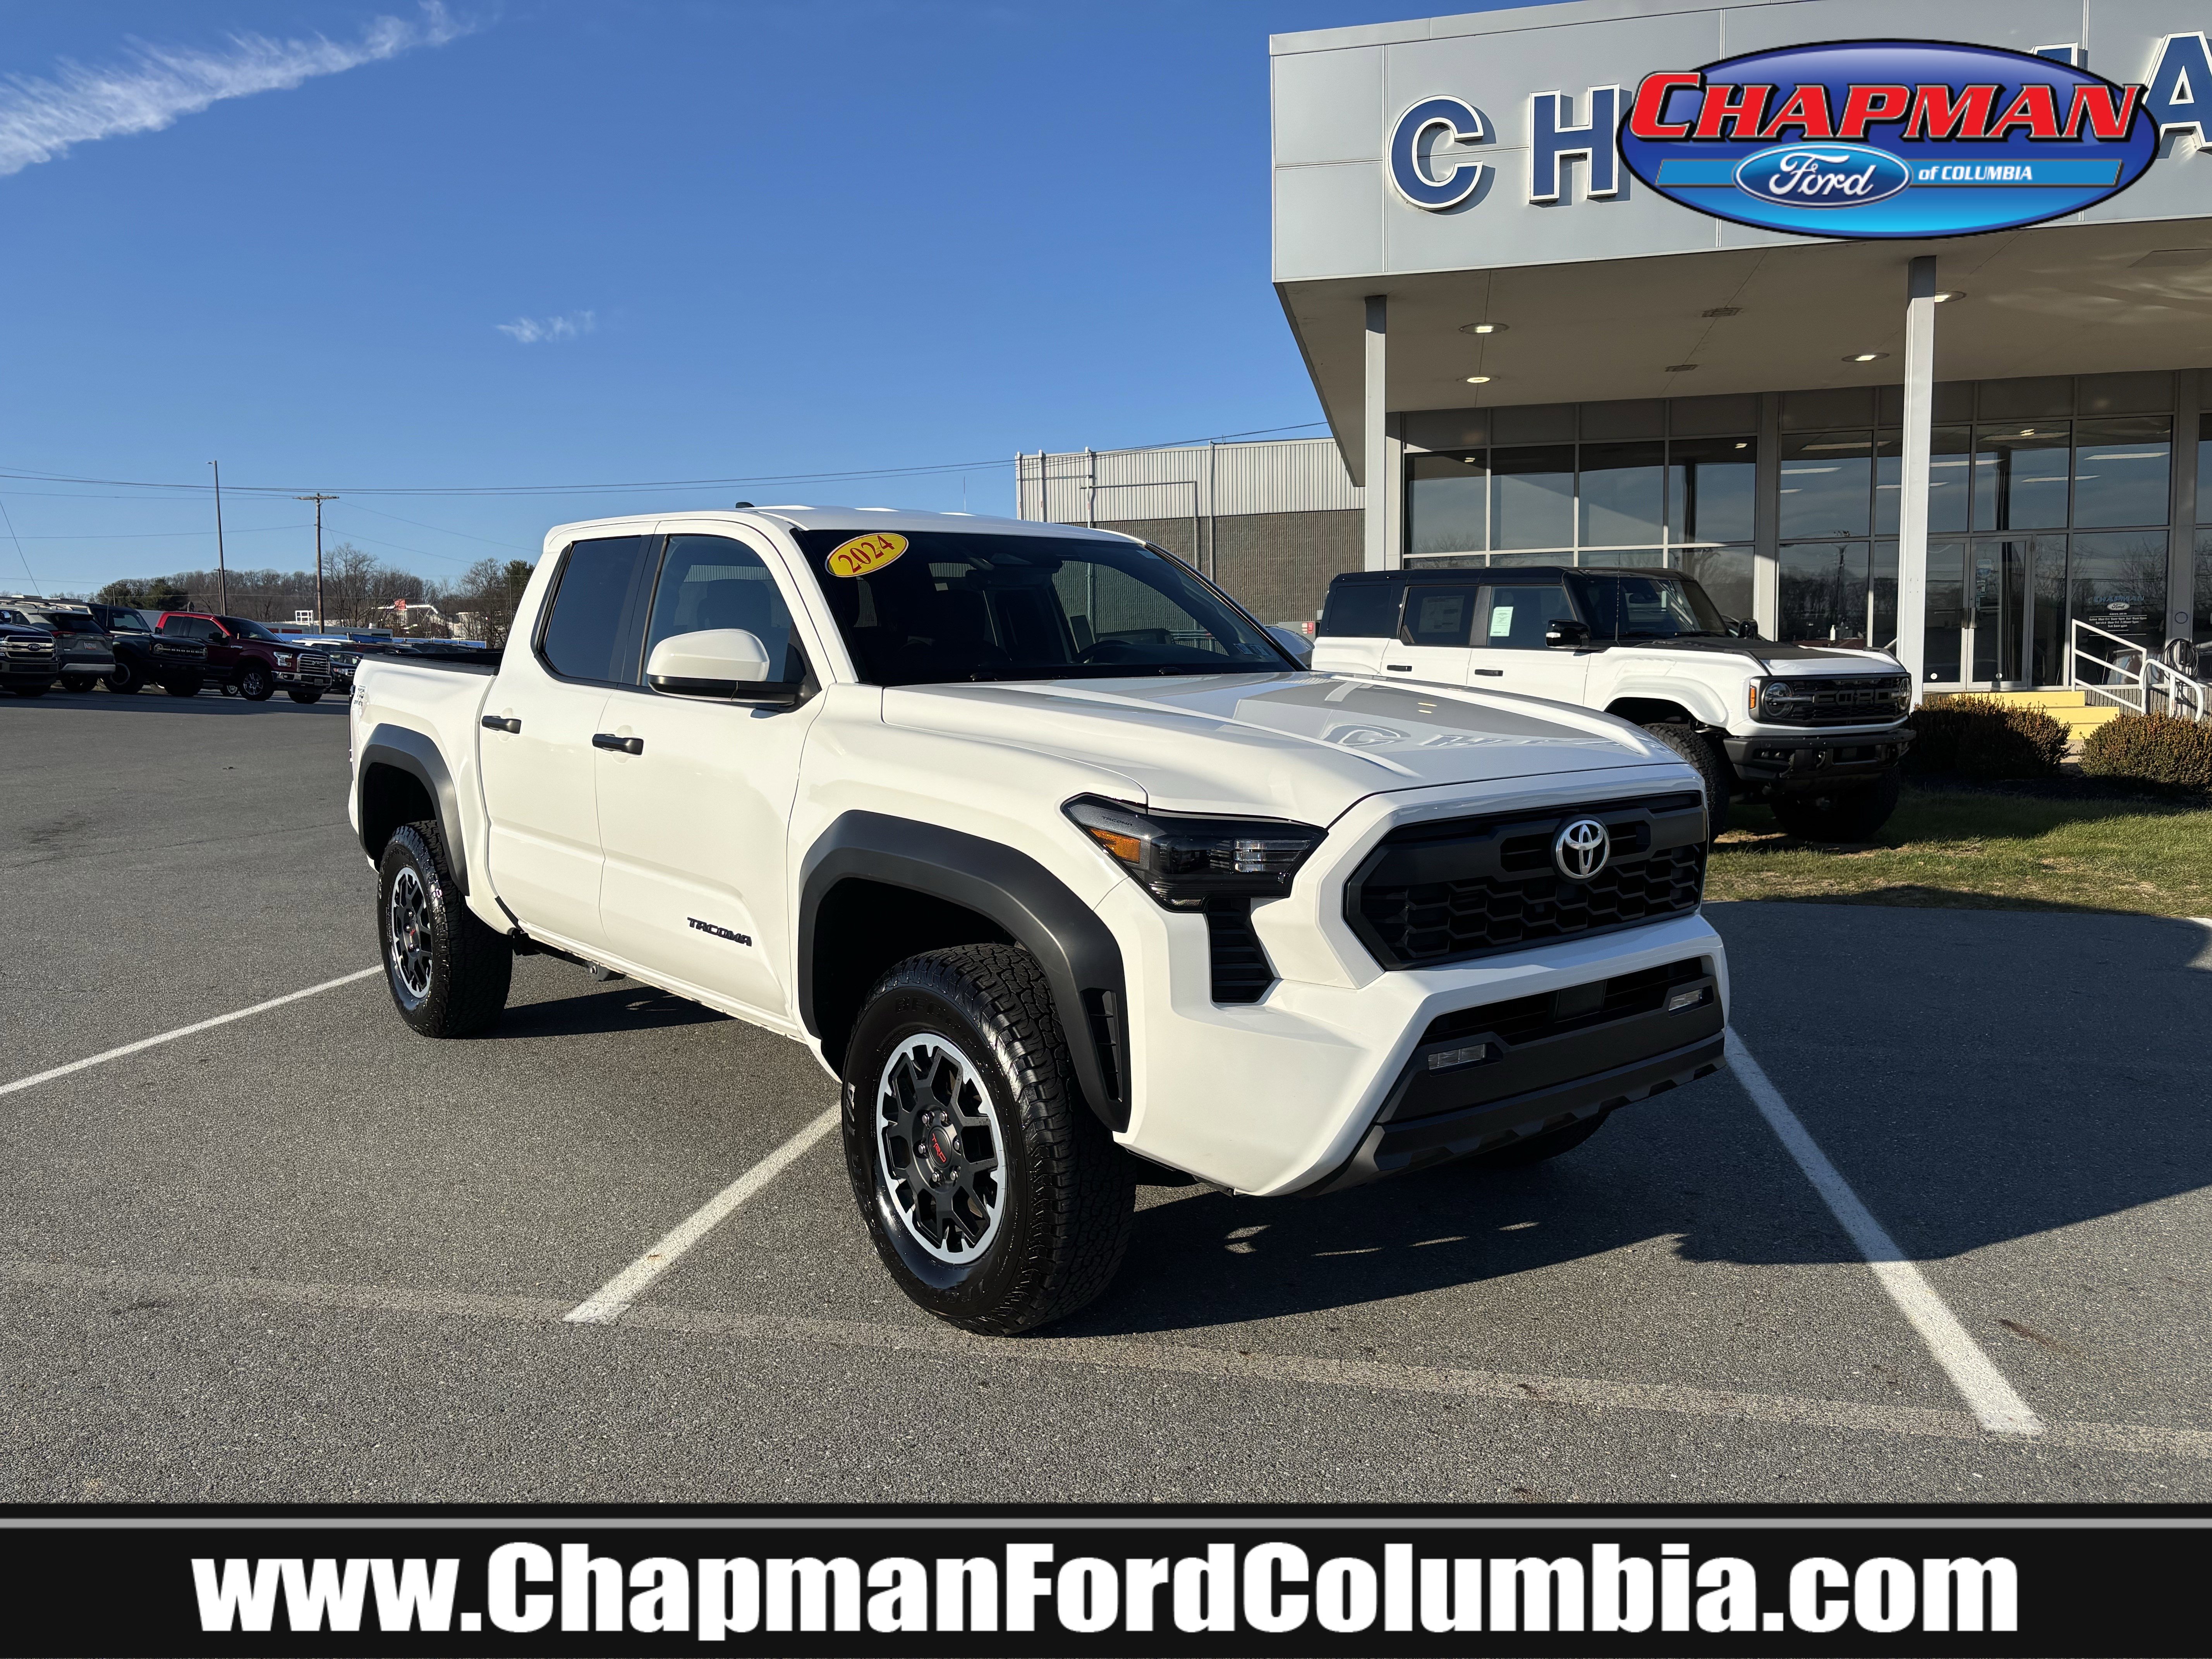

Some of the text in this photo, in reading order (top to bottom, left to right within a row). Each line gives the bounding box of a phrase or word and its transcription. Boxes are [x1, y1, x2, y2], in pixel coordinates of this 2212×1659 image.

[838, 535, 895, 573] 2024
[1815, 688, 1894, 706] FORD
[687, 917, 752, 947] TACOMA
[932, 1133, 946, 1163] TRD
